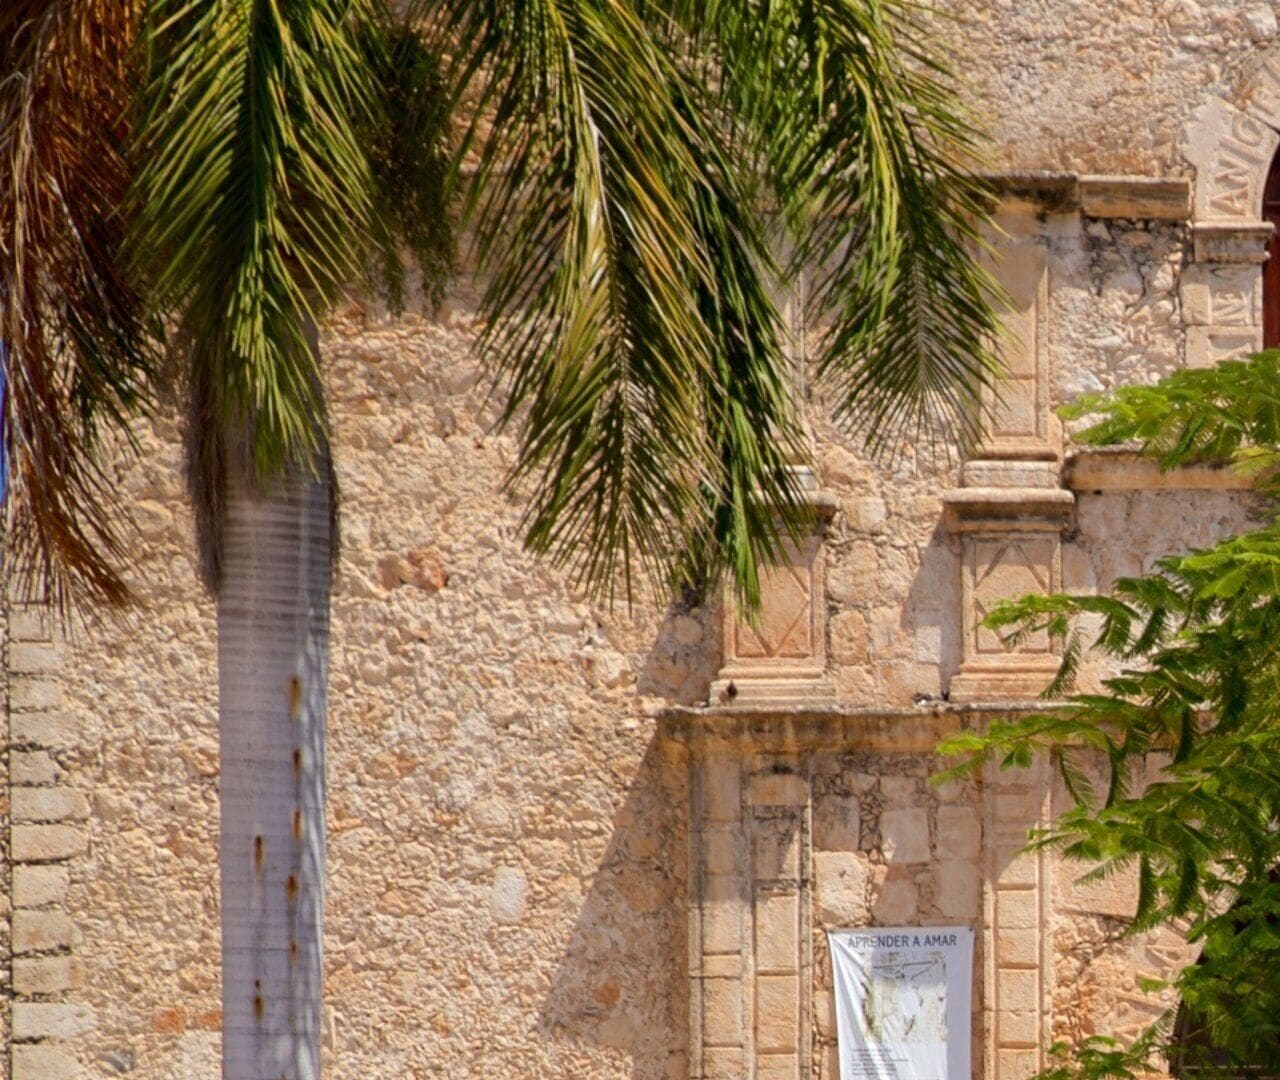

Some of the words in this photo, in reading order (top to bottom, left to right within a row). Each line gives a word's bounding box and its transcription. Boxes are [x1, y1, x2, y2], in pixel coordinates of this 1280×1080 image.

[848, 935, 909, 948] APRENDER
[912, 935, 921, 947] A
[924, 934, 957, 947] AMAR
